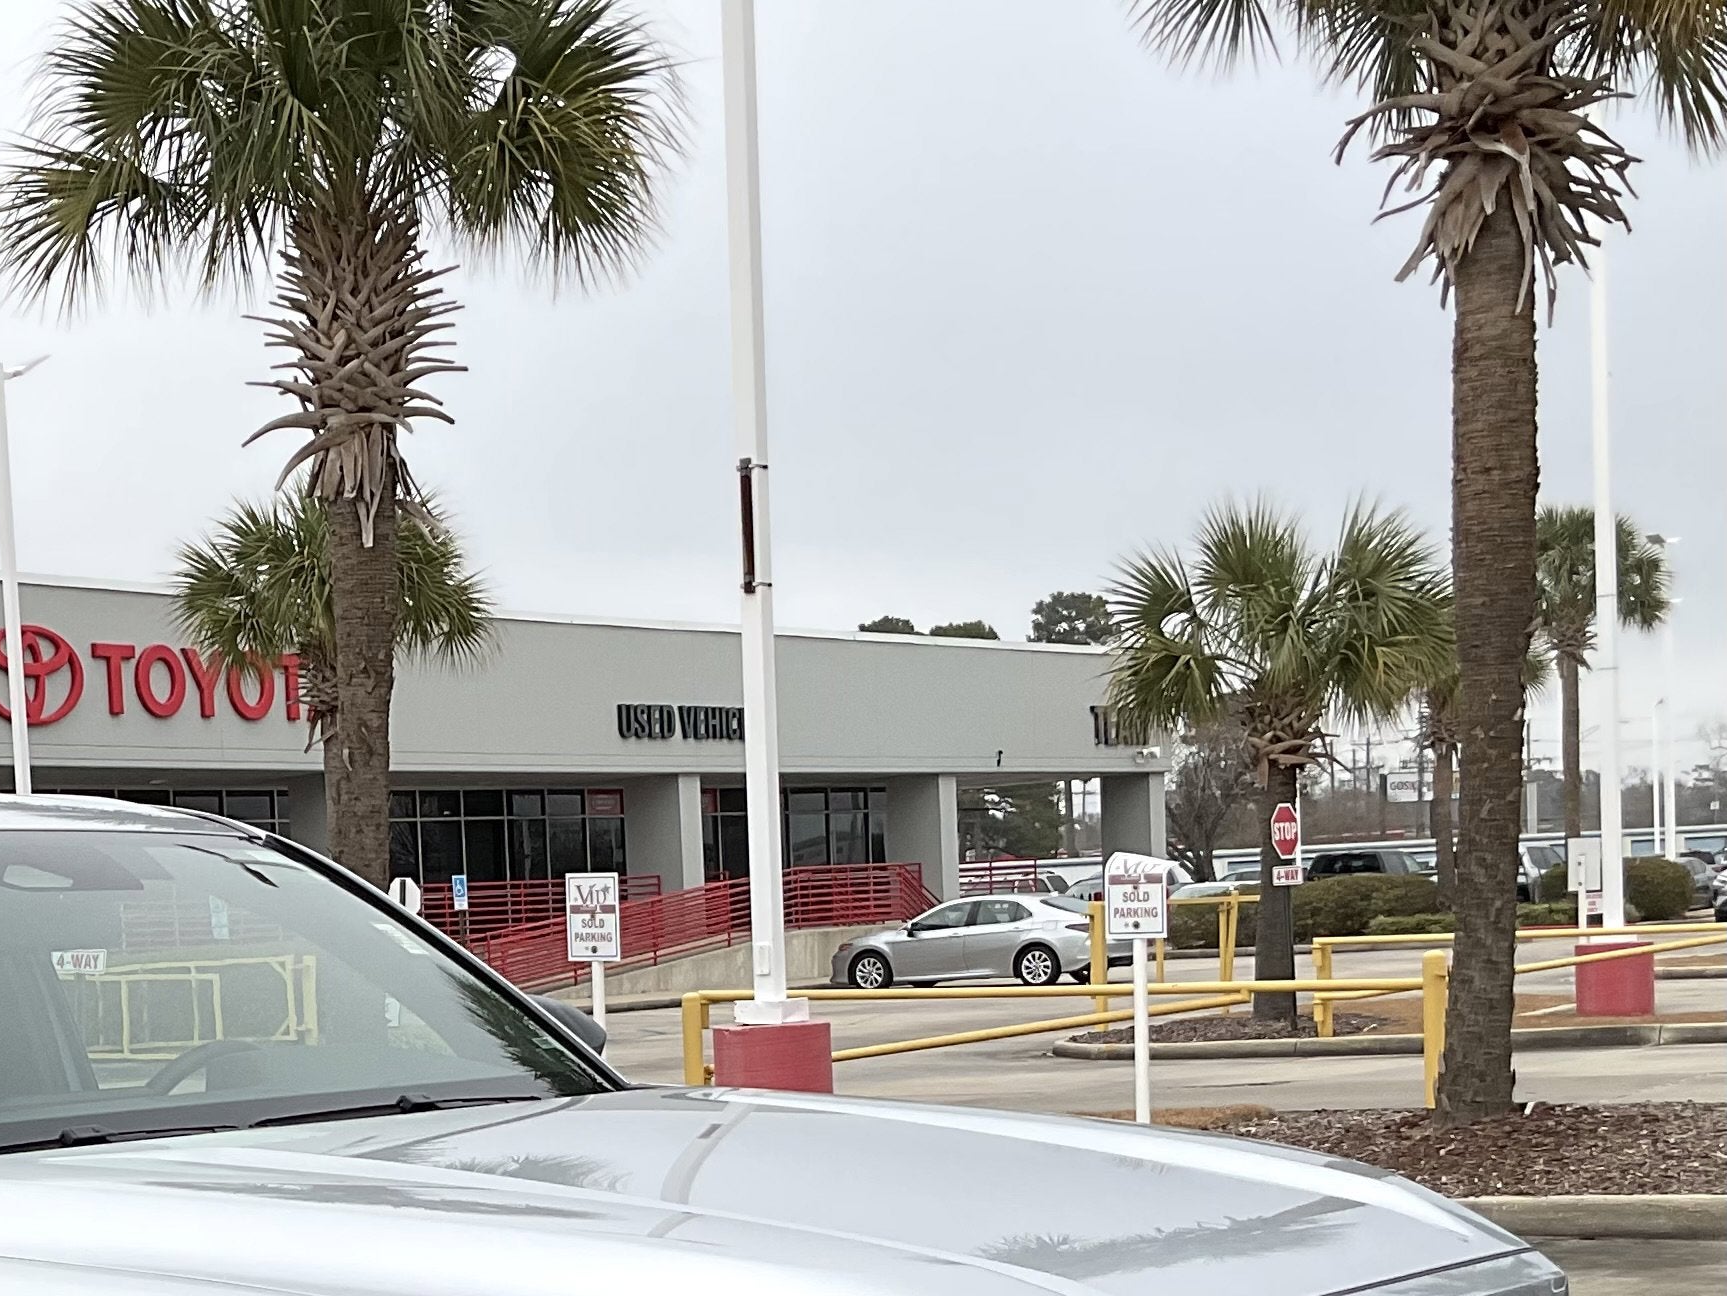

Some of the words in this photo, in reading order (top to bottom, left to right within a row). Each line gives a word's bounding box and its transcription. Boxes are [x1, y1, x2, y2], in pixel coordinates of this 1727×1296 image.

[91, 643, 318, 722] TOYOT
[616, 703, 676, 739] USED
[677, 705, 745, 741] VEHIC
[1273, 821, 1297, 841] STOP
[1276, 869, 1299, 882] 4-WAY
[1122, 891, 1150, 902] SOLD
[1113, 907, 1158, 918] PARKING
[581, 918, 605, 929] SOLD
[574, 931, 613, 943] PARKING
[56, 953, 100, 969] 4-WAY
